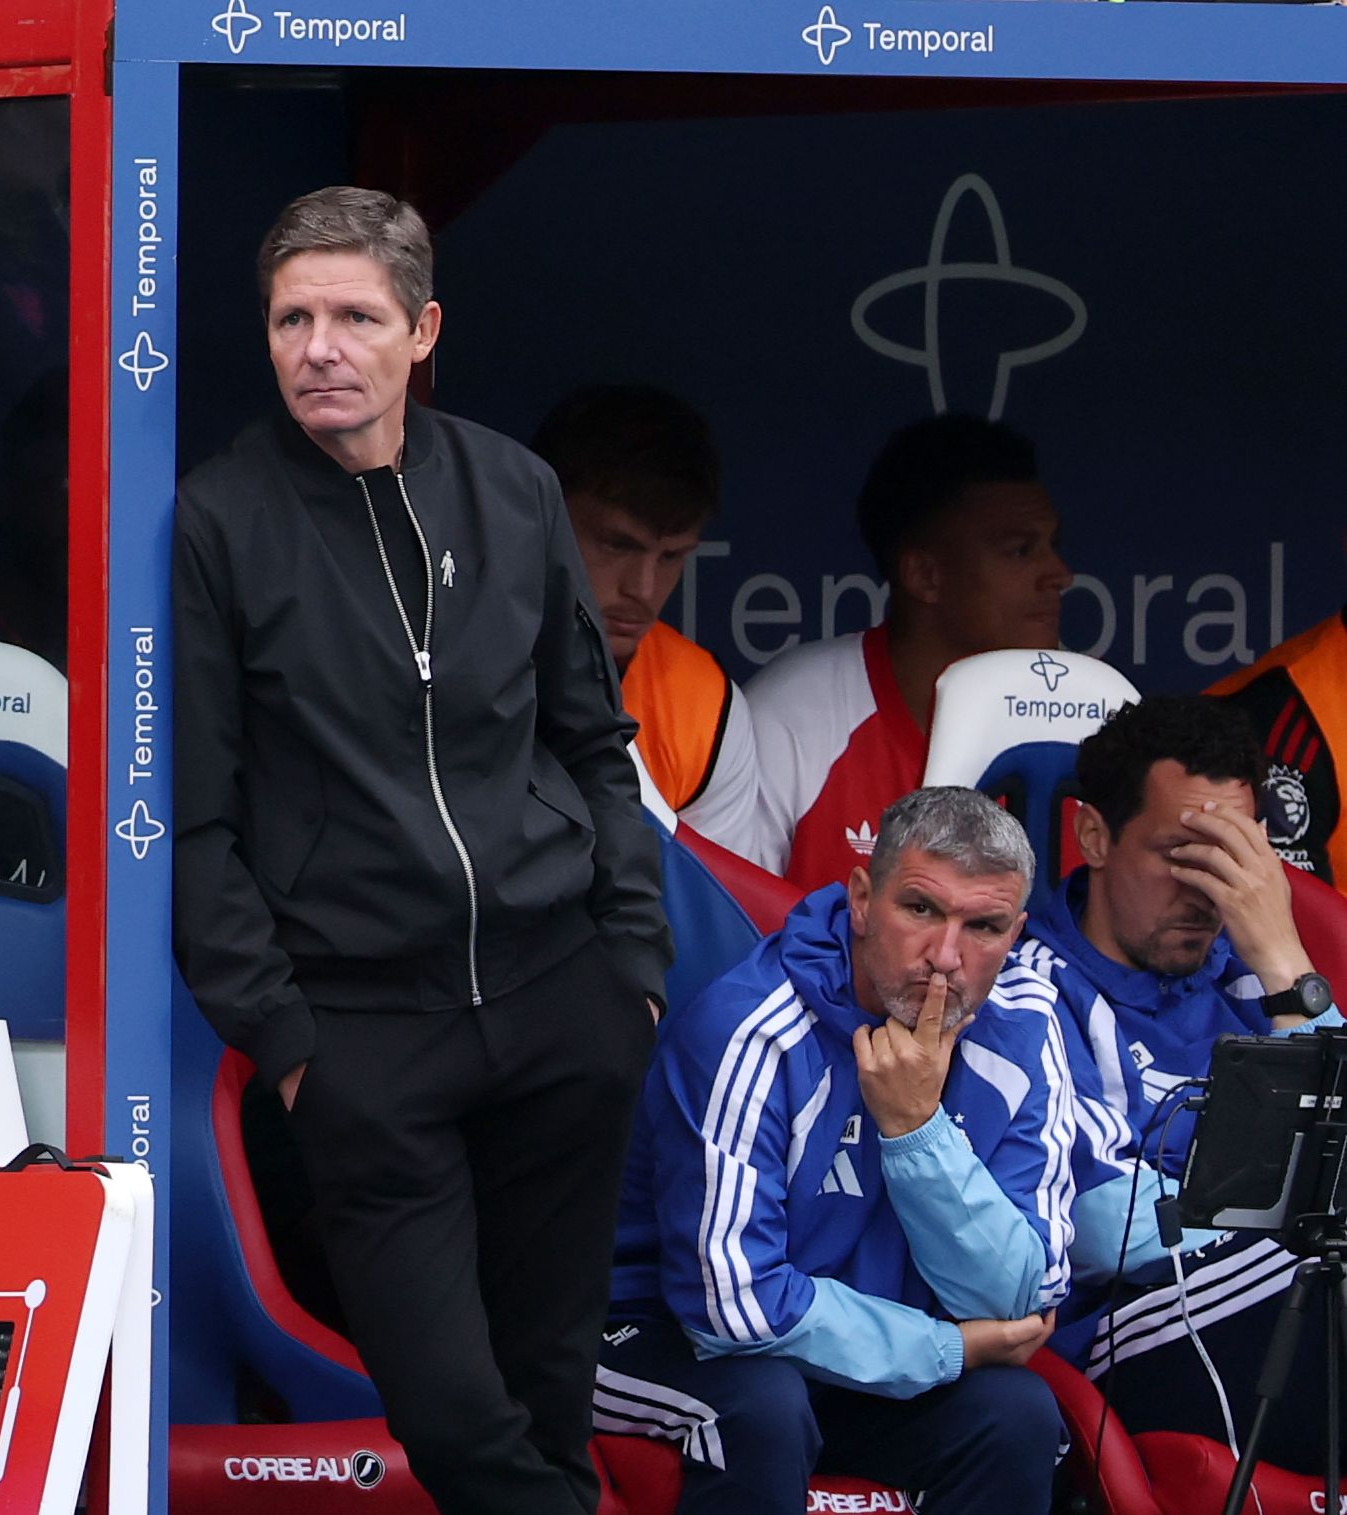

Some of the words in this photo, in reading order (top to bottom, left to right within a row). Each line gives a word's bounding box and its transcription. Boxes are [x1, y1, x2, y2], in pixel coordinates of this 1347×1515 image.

[273, 11, 405, 47] Temporal
[863, 22, 994, 58] Temporal
[133, 158, 162, 317] Temporal
[129, 627, 158, 785] Temporal
[1003, 695, 1107, 722] Temporal
[224, 1457, 352, 1482] CORBEAU
